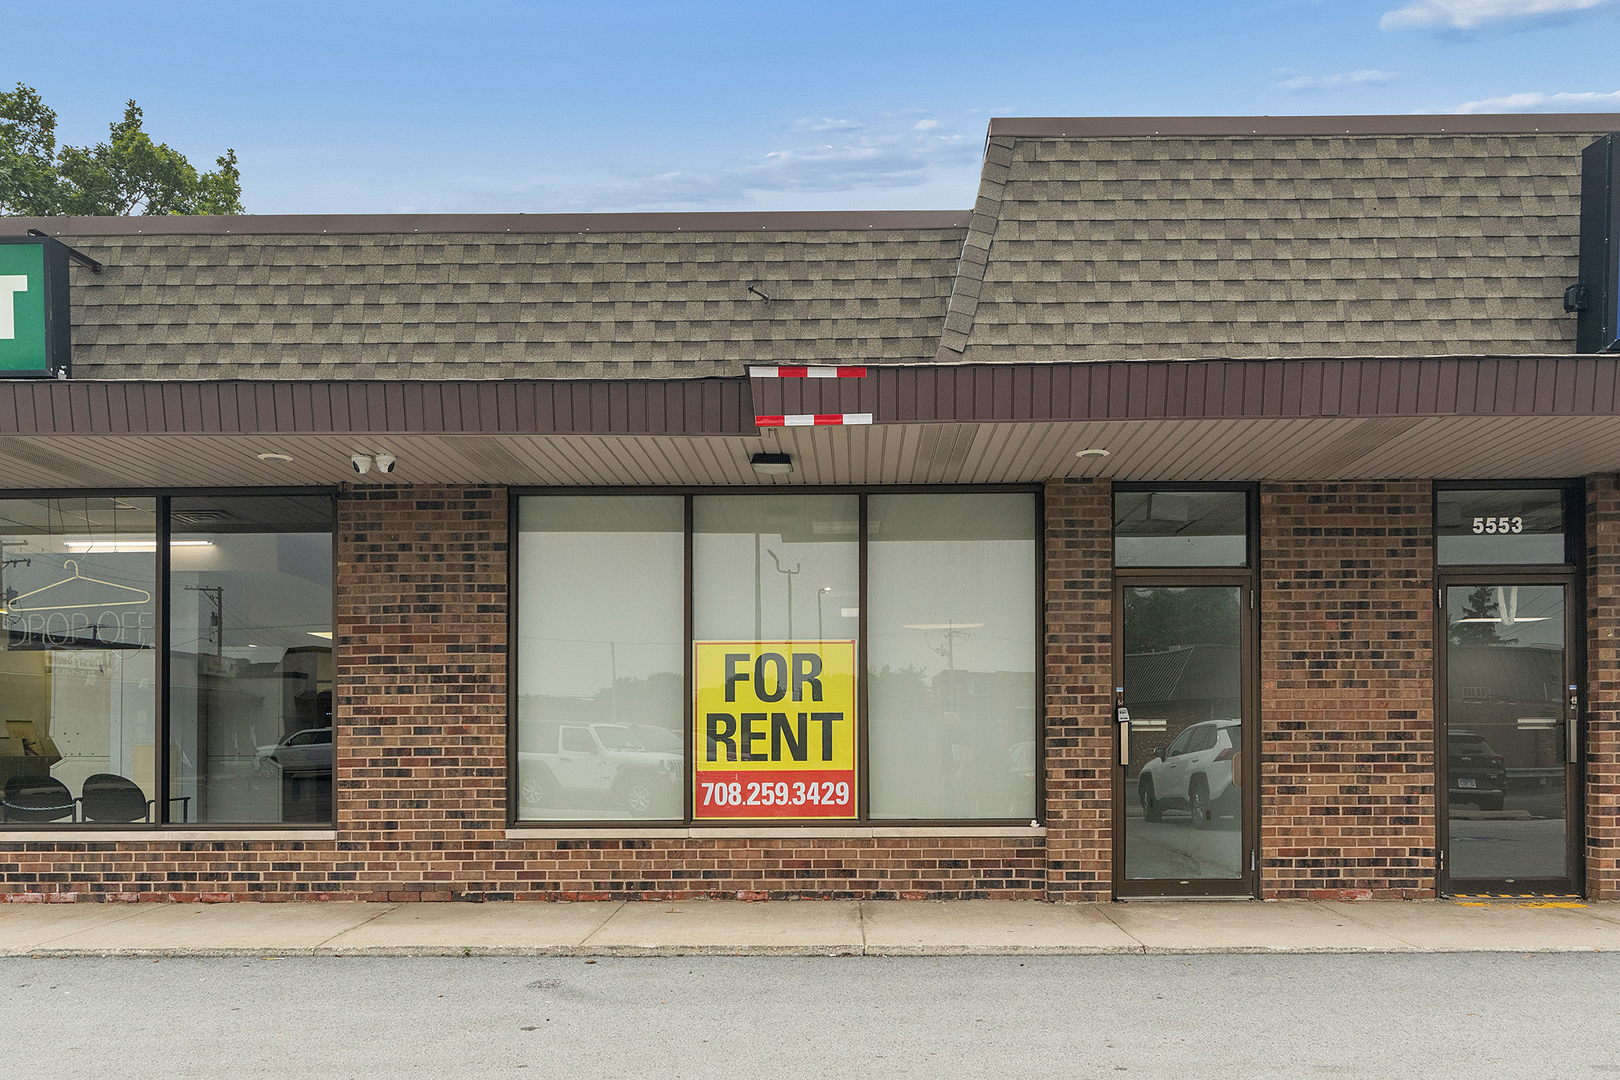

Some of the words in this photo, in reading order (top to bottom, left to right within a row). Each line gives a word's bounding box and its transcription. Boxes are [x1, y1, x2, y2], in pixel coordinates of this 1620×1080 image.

[1472, 516, 1523, 534] 5553
[8, 612, 90, 647] DROP
[97, 610, 153, 645] OFF
[724, 652, 823, 703] FOR
[706, 712, 844, 762] RENT
[701, 782, 849, 806] 708.259.3429
